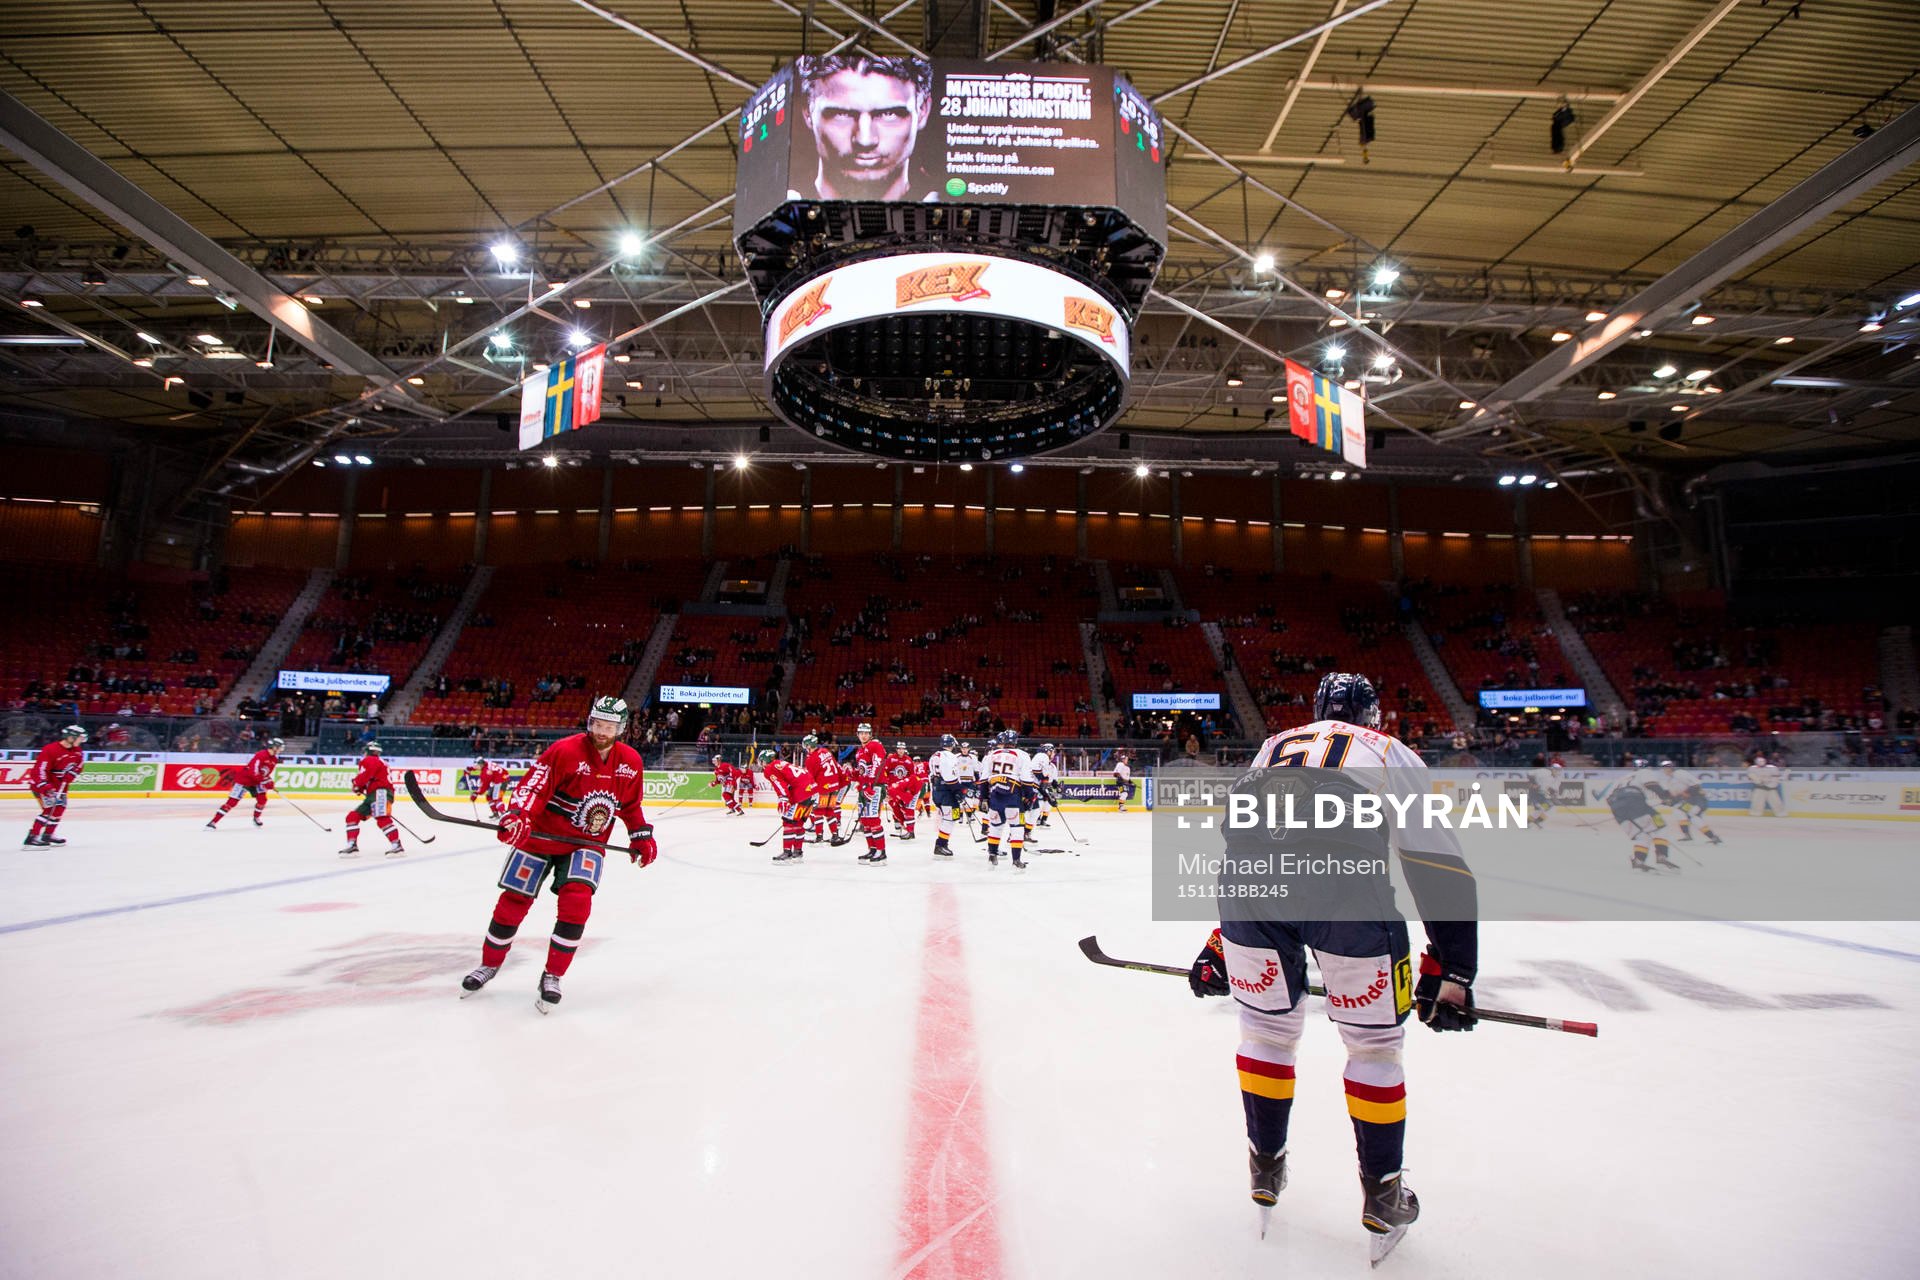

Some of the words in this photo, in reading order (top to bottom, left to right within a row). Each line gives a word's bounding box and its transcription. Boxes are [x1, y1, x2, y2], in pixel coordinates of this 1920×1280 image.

[946, 81, 1031, 98] MATCHENS
[1033, 83, 1092, 100] PROFIL:
[940, 97, 962, 116] 28
[963, 97, 1008, 117] JOHAN
[947, 123, 980, 134] Under
[981, 124, 1063, 138] uppvärmningen
[946, 134, 985, 146] lyssnar
[986, 134, 997, 145] vi
[998, 134, 1011, 147] på
[1013, 136, 1052, 147] Johans
[946, 152, 974, 163] Länk
[975, 152, 1003, 163] finns
[1004, 152, 1019, 165] på
[946, 163, 1055, 176] frolundaindians.com
[967, 182, 1009, 195] Spotify
[900, 263, 983, 303] KEX
[326, 677, 367, 685] julbordet
[698, 691, 731, 699] julbordet
[1170, 697, 1202, 705] julbordet
[276, 771, 319, 788] 200
[1065, 786, 1121, 797] Mattkillarn
[1810, 793, 1887, 802] EASTON
[1229, 959, 1279, 993] zehnder
